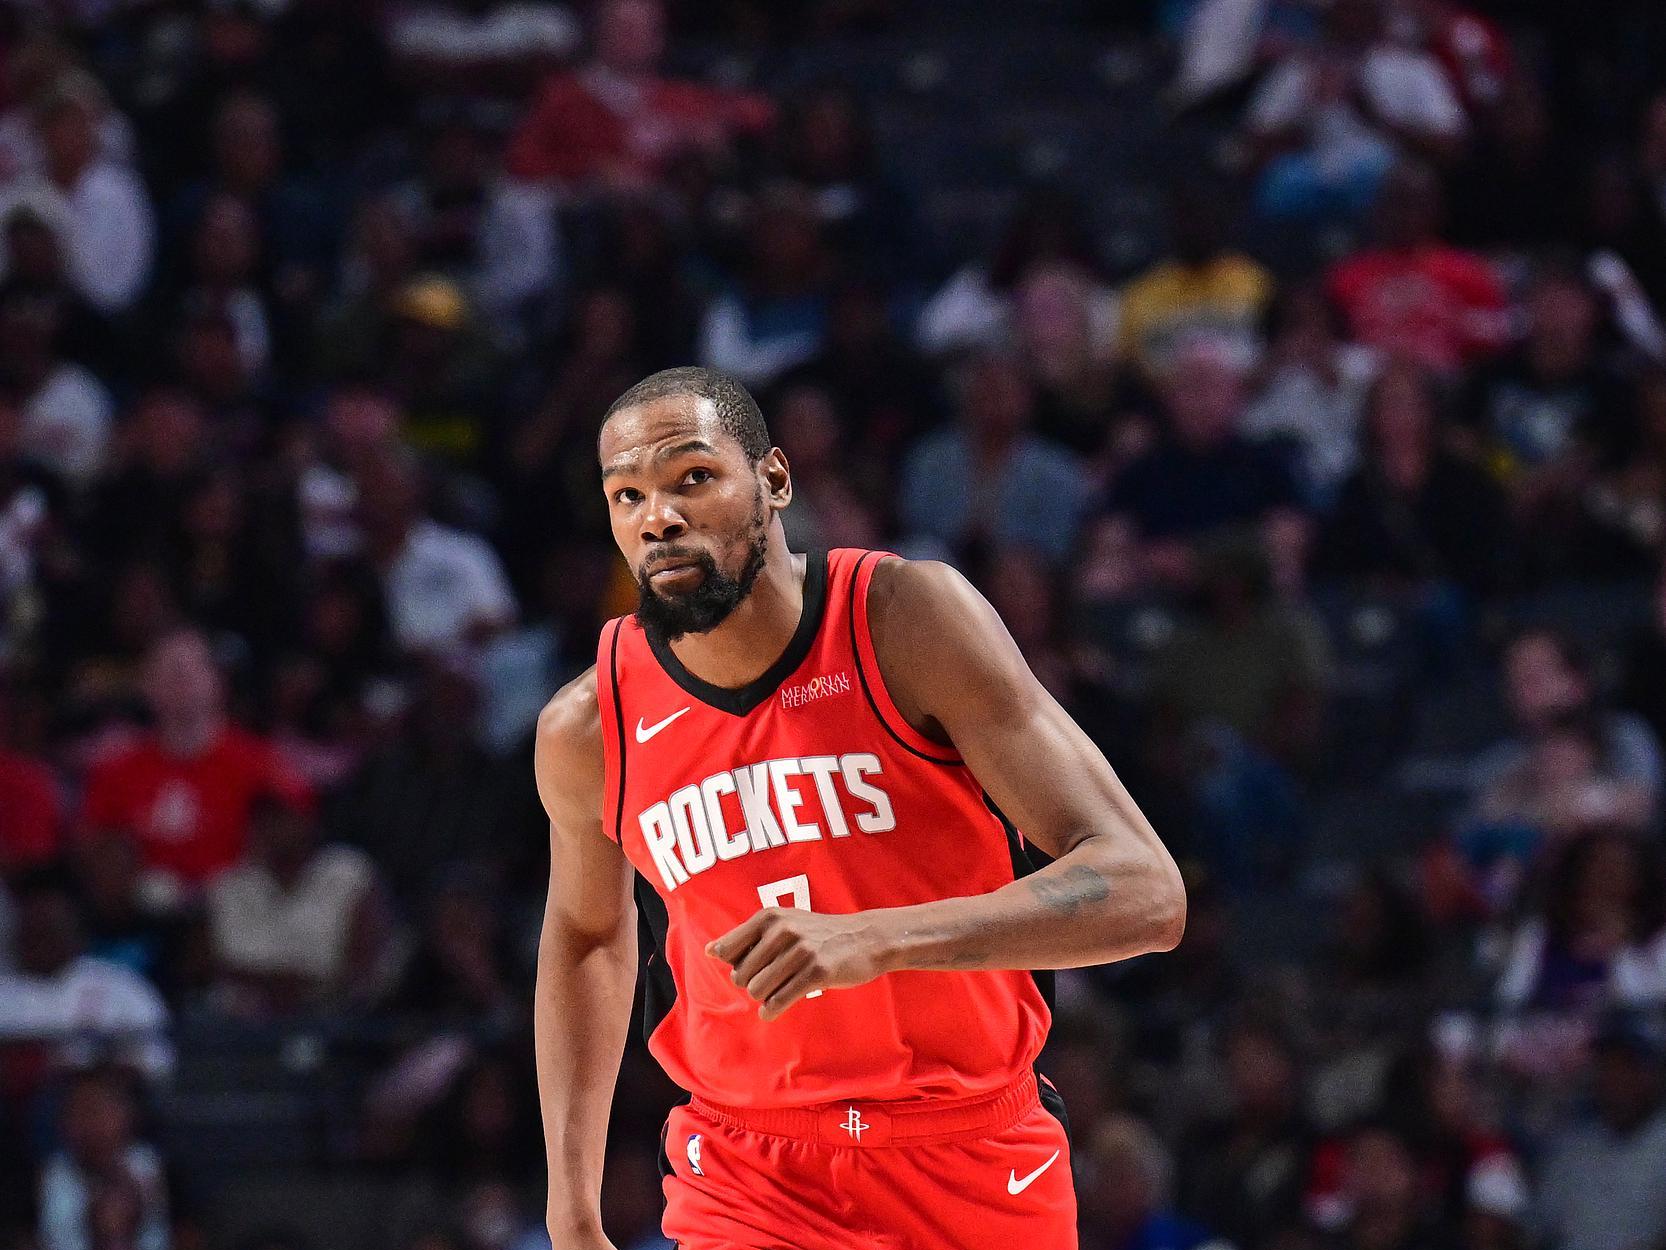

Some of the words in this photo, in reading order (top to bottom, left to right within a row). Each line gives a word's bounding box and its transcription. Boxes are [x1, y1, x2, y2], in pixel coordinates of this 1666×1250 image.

[781, 672, 848, 699] MEMORIAL
[782, 679, 850, 709] HERMANN
[638, 752, 897, 890] ROCKETS
